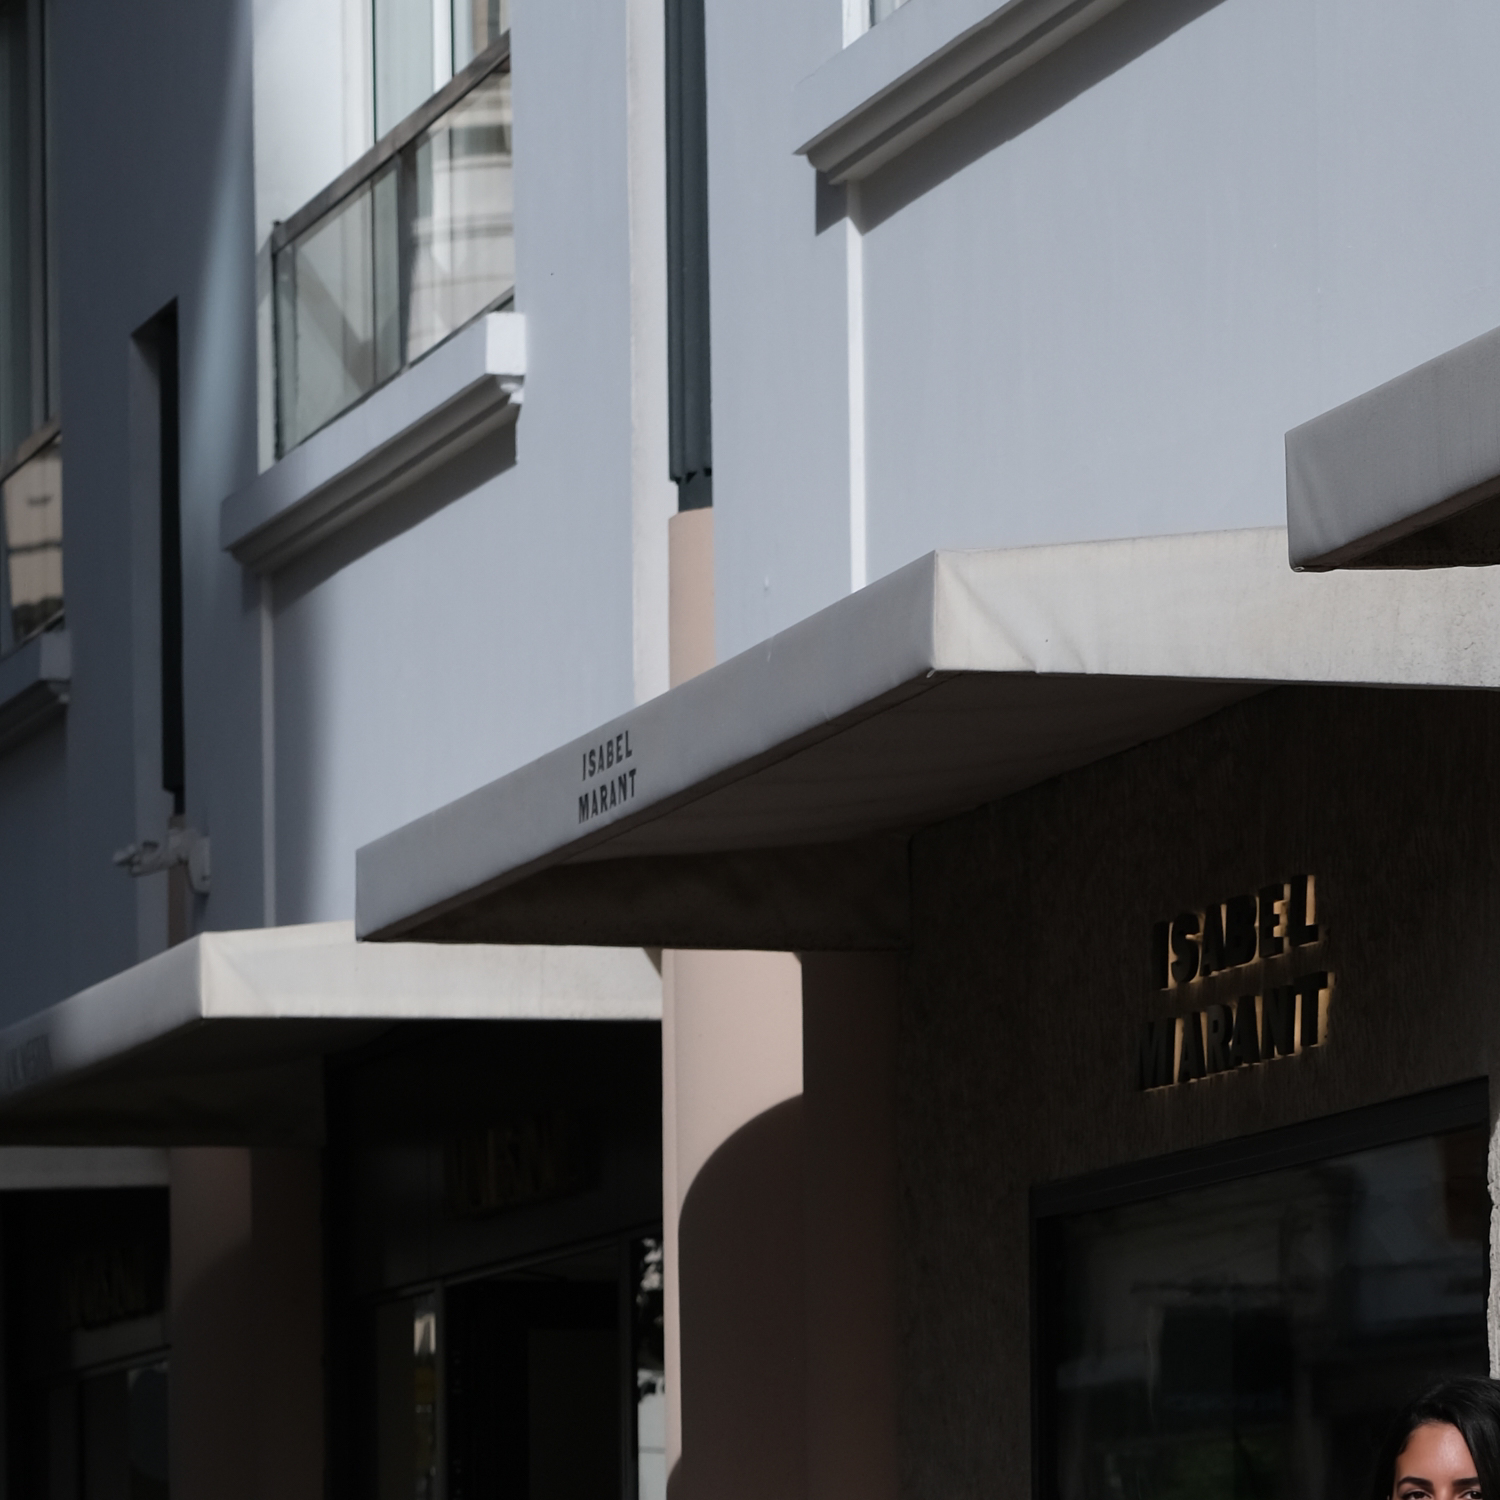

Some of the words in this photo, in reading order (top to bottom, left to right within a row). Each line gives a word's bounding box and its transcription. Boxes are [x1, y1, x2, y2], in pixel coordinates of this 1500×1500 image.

[578, 768, 637, 824] MARANT
[582, 730, 633, 782] ISABEL
[1153, 874, 1319, 991] ISABEL
[1139, 971, 1334, 1092] MARANT
